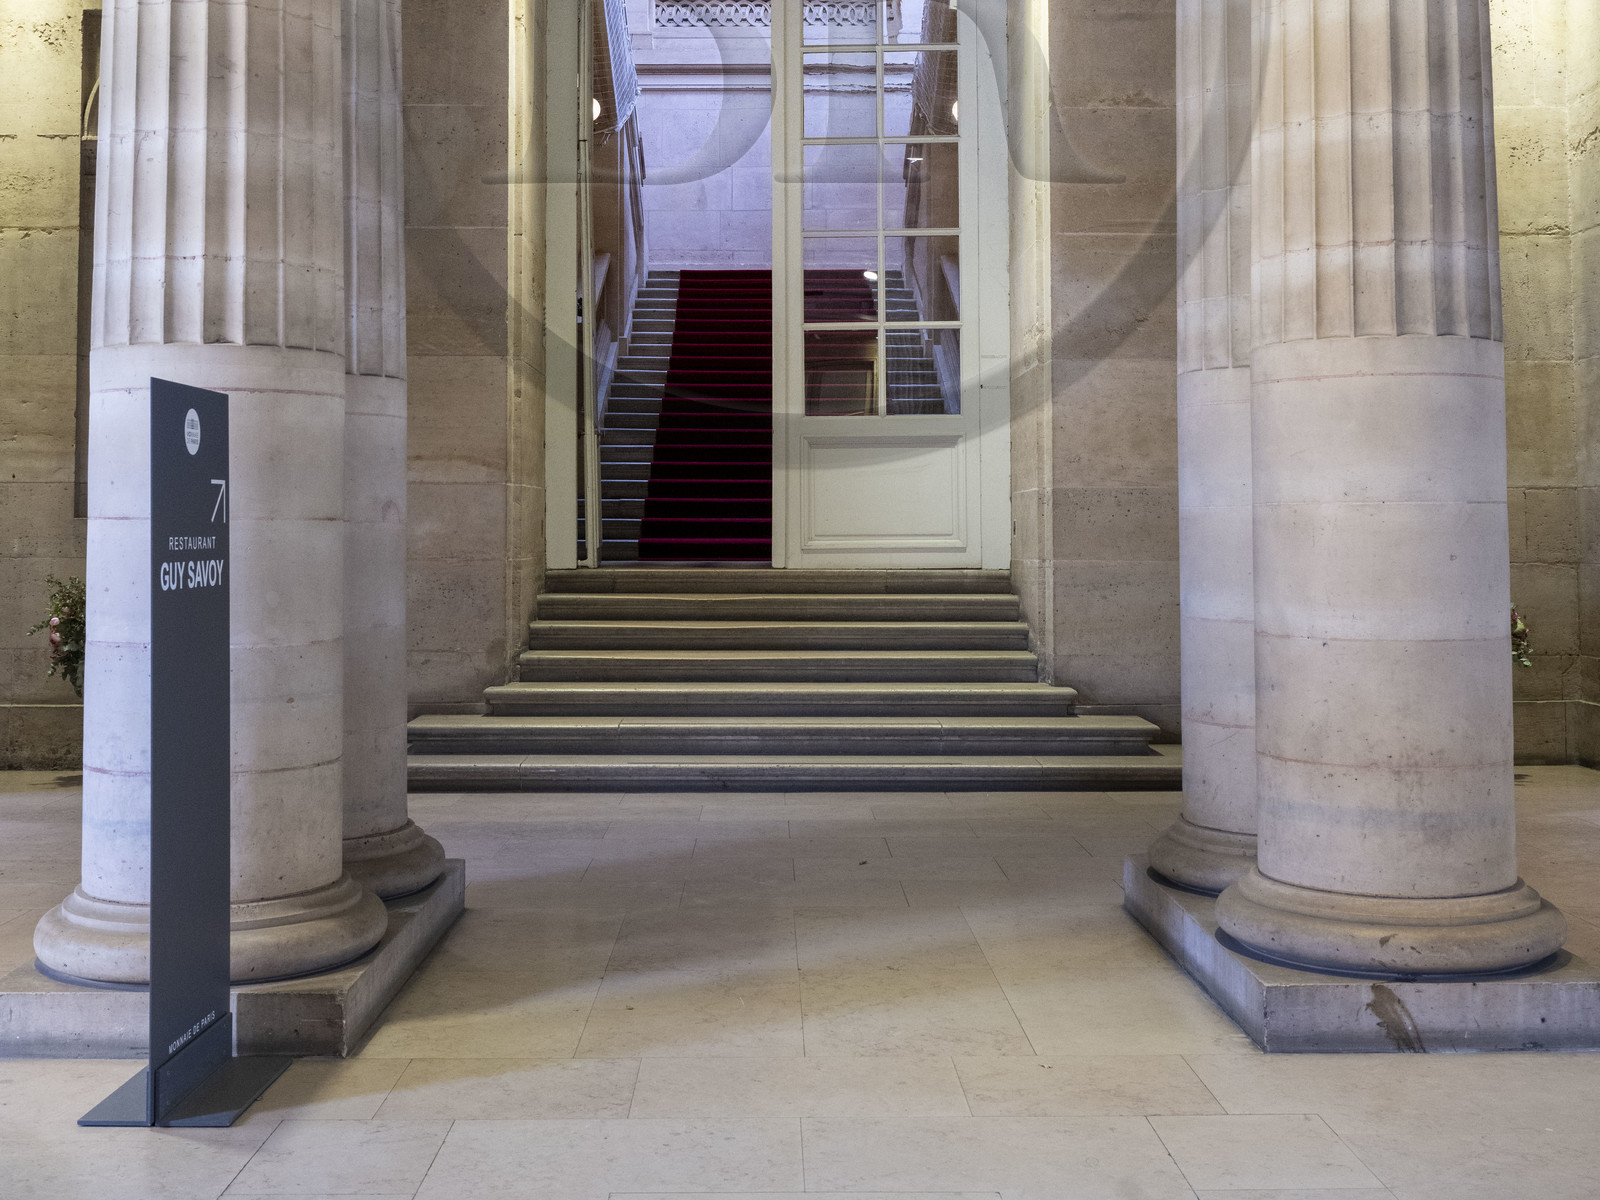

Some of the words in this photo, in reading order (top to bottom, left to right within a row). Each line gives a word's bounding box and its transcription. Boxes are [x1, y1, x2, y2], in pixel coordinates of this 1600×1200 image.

[168, 536, 216, 550] RESTAURANT
[160, 561, 186, 591] GUY
[187, 559, 224, 589] SAVOY
[168, 1028, 192, 1055] MONNAIE
[192, 1022, 200, 1035] DE
[200, 1010, 216, 1029] PARIS
